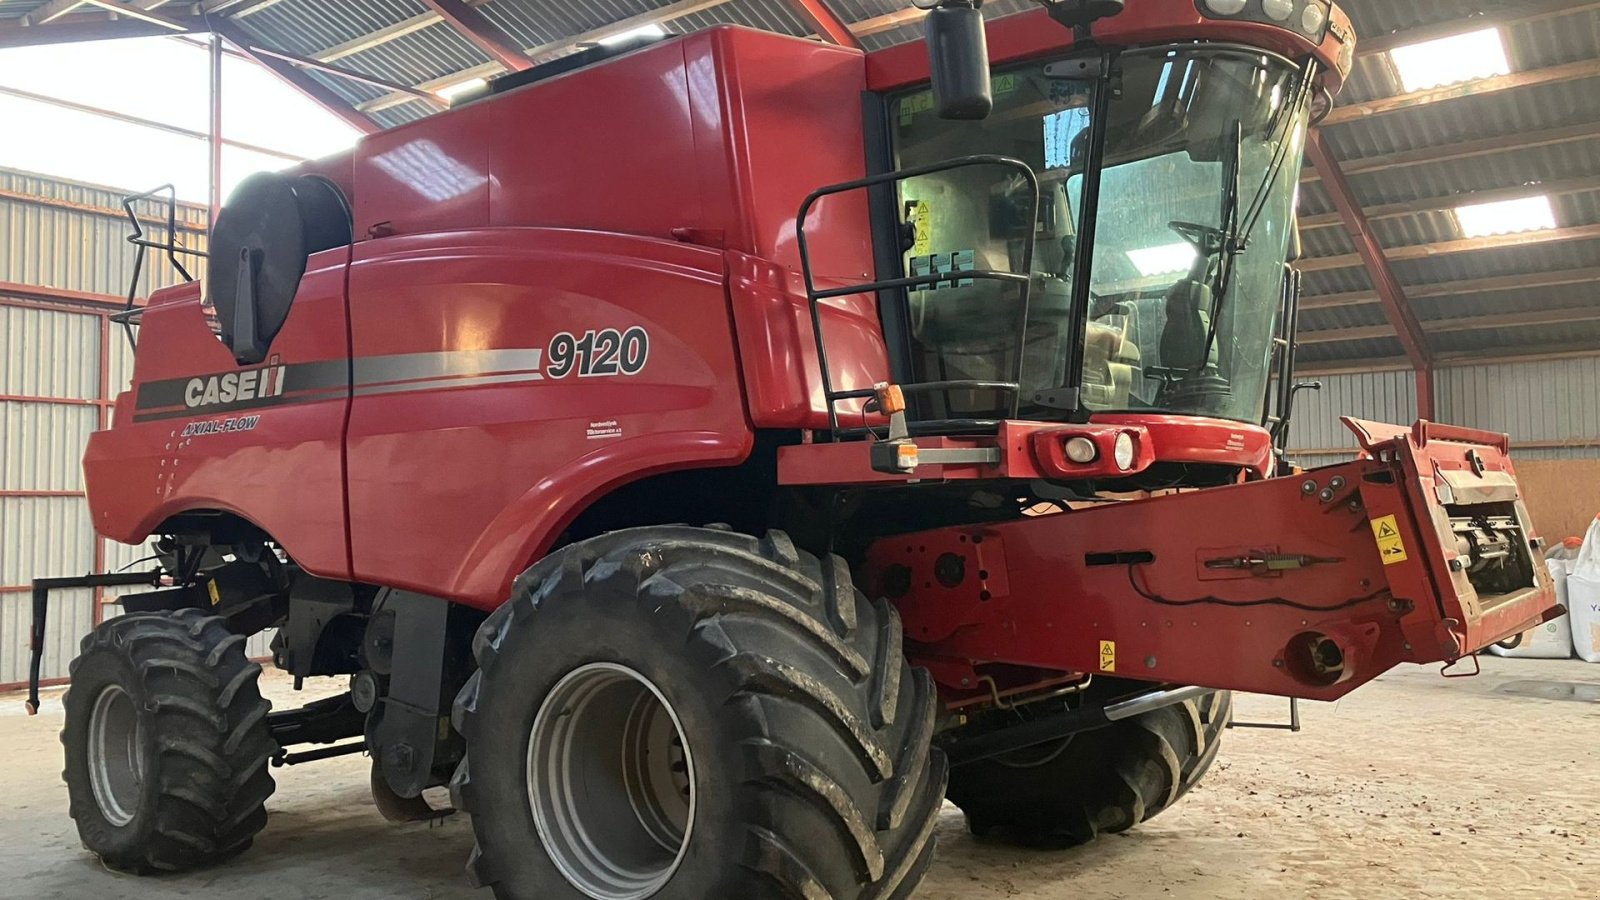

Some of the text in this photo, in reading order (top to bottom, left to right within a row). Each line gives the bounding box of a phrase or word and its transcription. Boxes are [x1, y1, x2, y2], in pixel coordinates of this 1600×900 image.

[547, 326, 649, 379] 9120
[184, 370, 258, 408] CASE
[181, 415, 260, 437] AXIAL-FLOW
